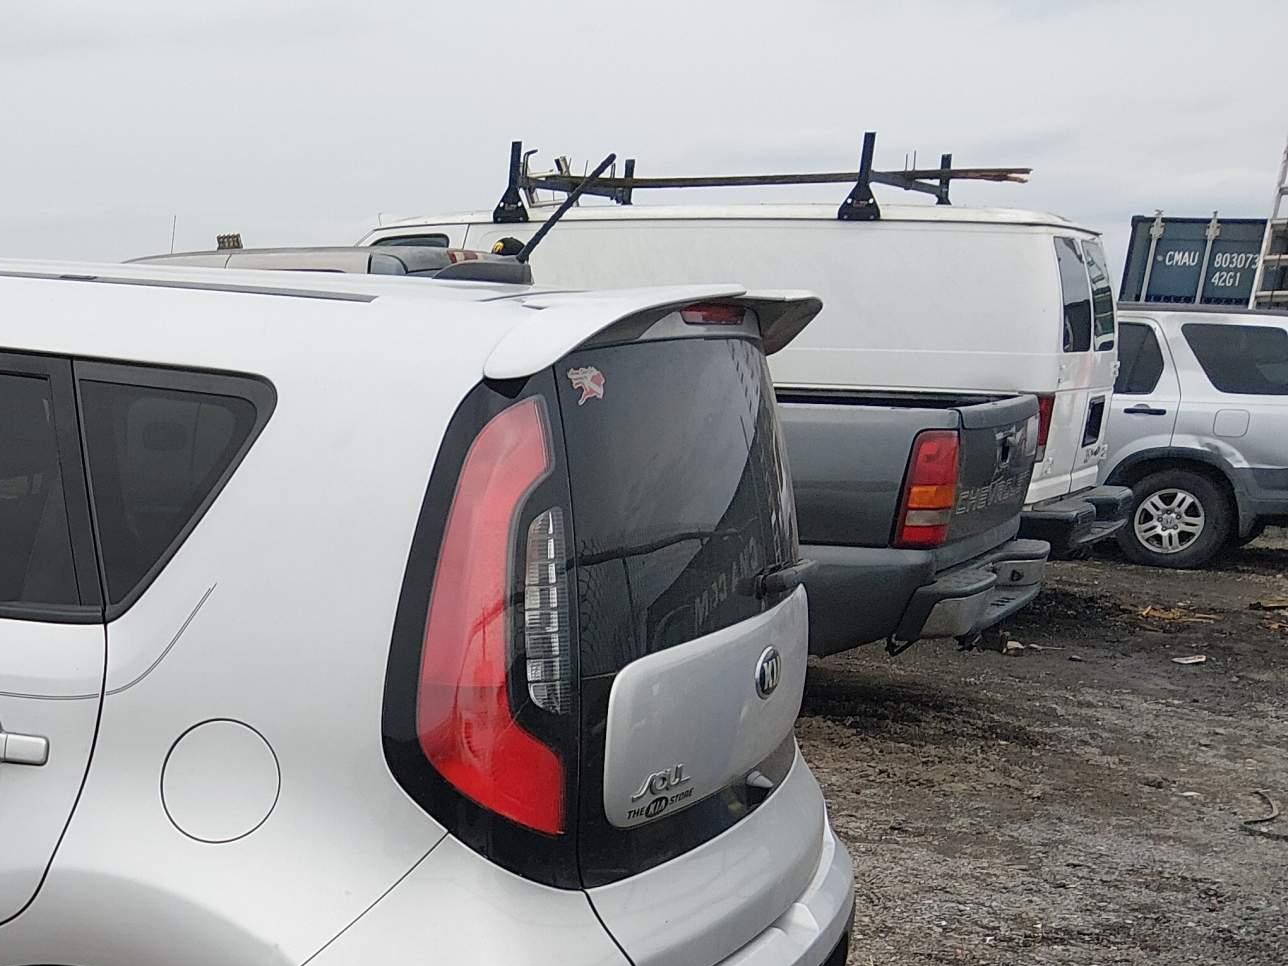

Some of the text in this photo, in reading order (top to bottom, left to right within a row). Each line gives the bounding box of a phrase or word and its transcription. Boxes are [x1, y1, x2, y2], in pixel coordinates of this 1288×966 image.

[1165, 251, 1259, 269] CMAU 803073
[1211, 271, 1241, 287] 42G1
[627, 806, 646, 820] THE
